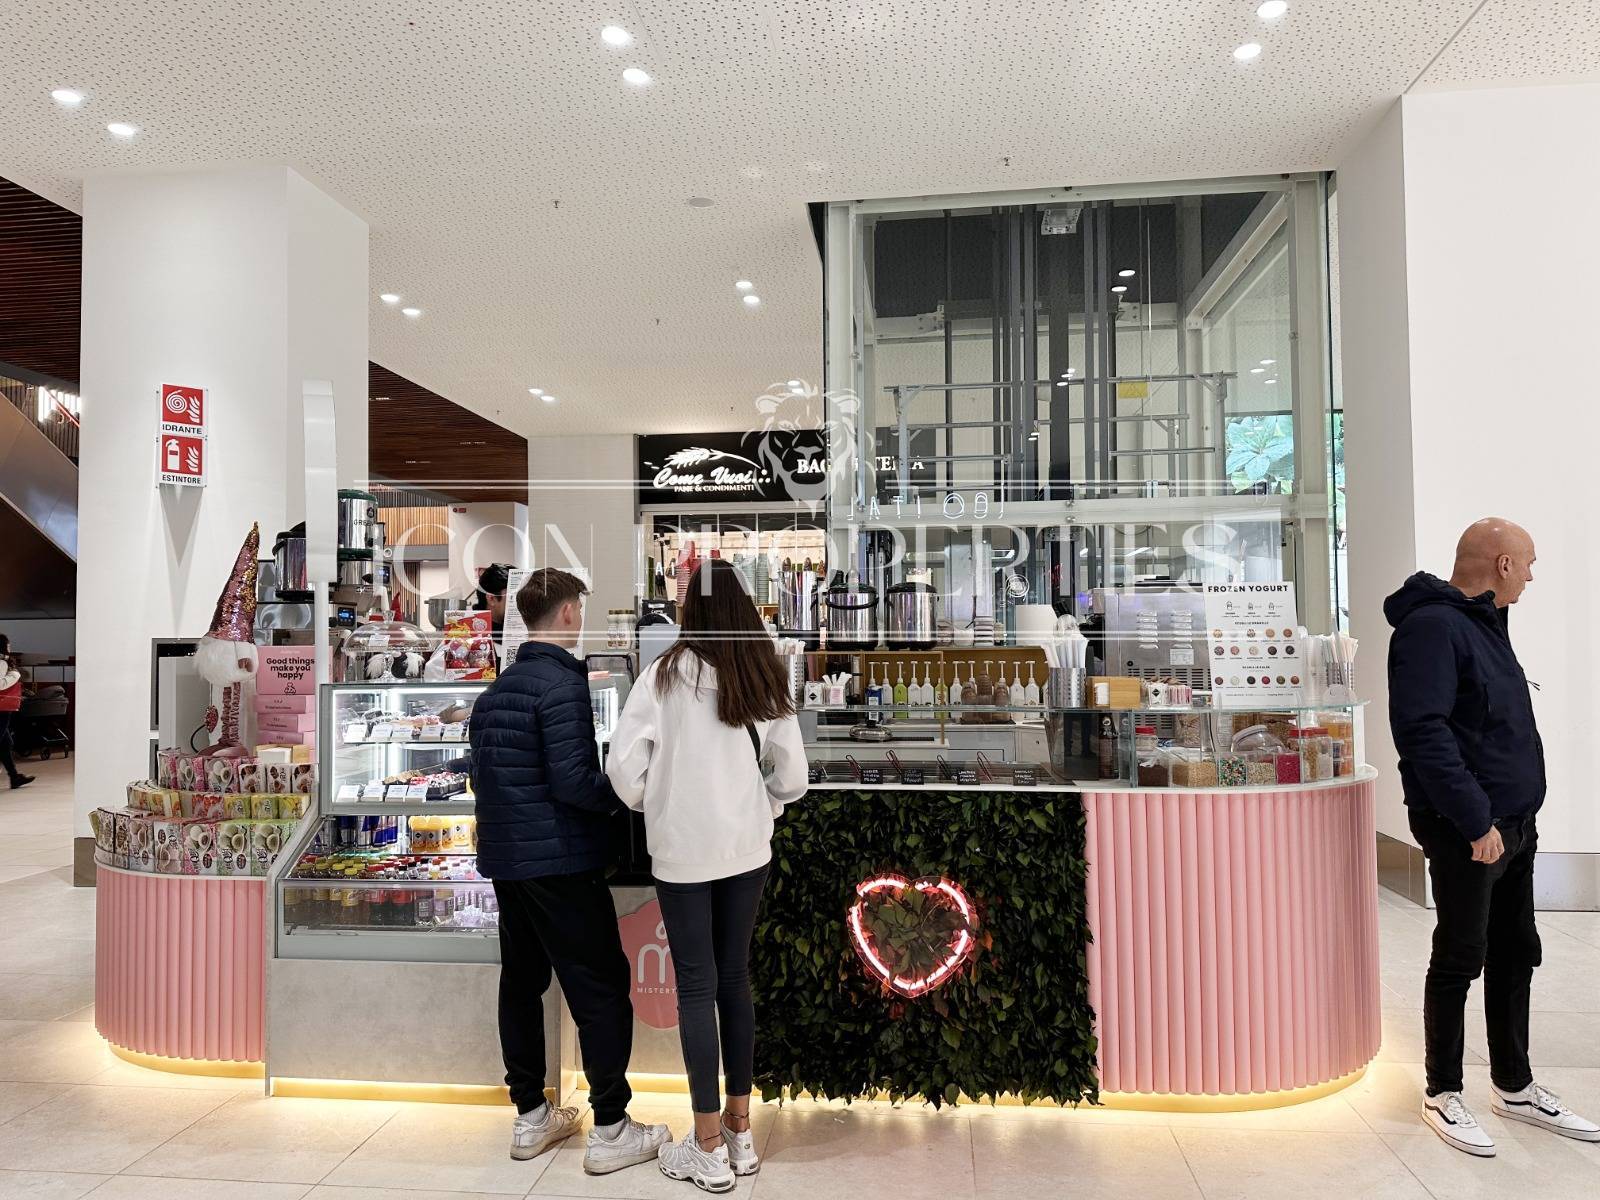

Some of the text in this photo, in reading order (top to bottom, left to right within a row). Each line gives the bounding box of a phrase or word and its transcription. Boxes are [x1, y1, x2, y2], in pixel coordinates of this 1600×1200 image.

[162, 424, 203, 435] IDRANTE
[162, 475, 201, 485] ESTINTORE
[653, 468, 704, 489] Come
[703, 485, 755, 493] CONDIMENTI
[1208, 585, 1246, 593] FROZEN
[266, 657, 315, 666] Good things
[270, 664, 311, 674] make you
[277, 671, 304, 680] happy
